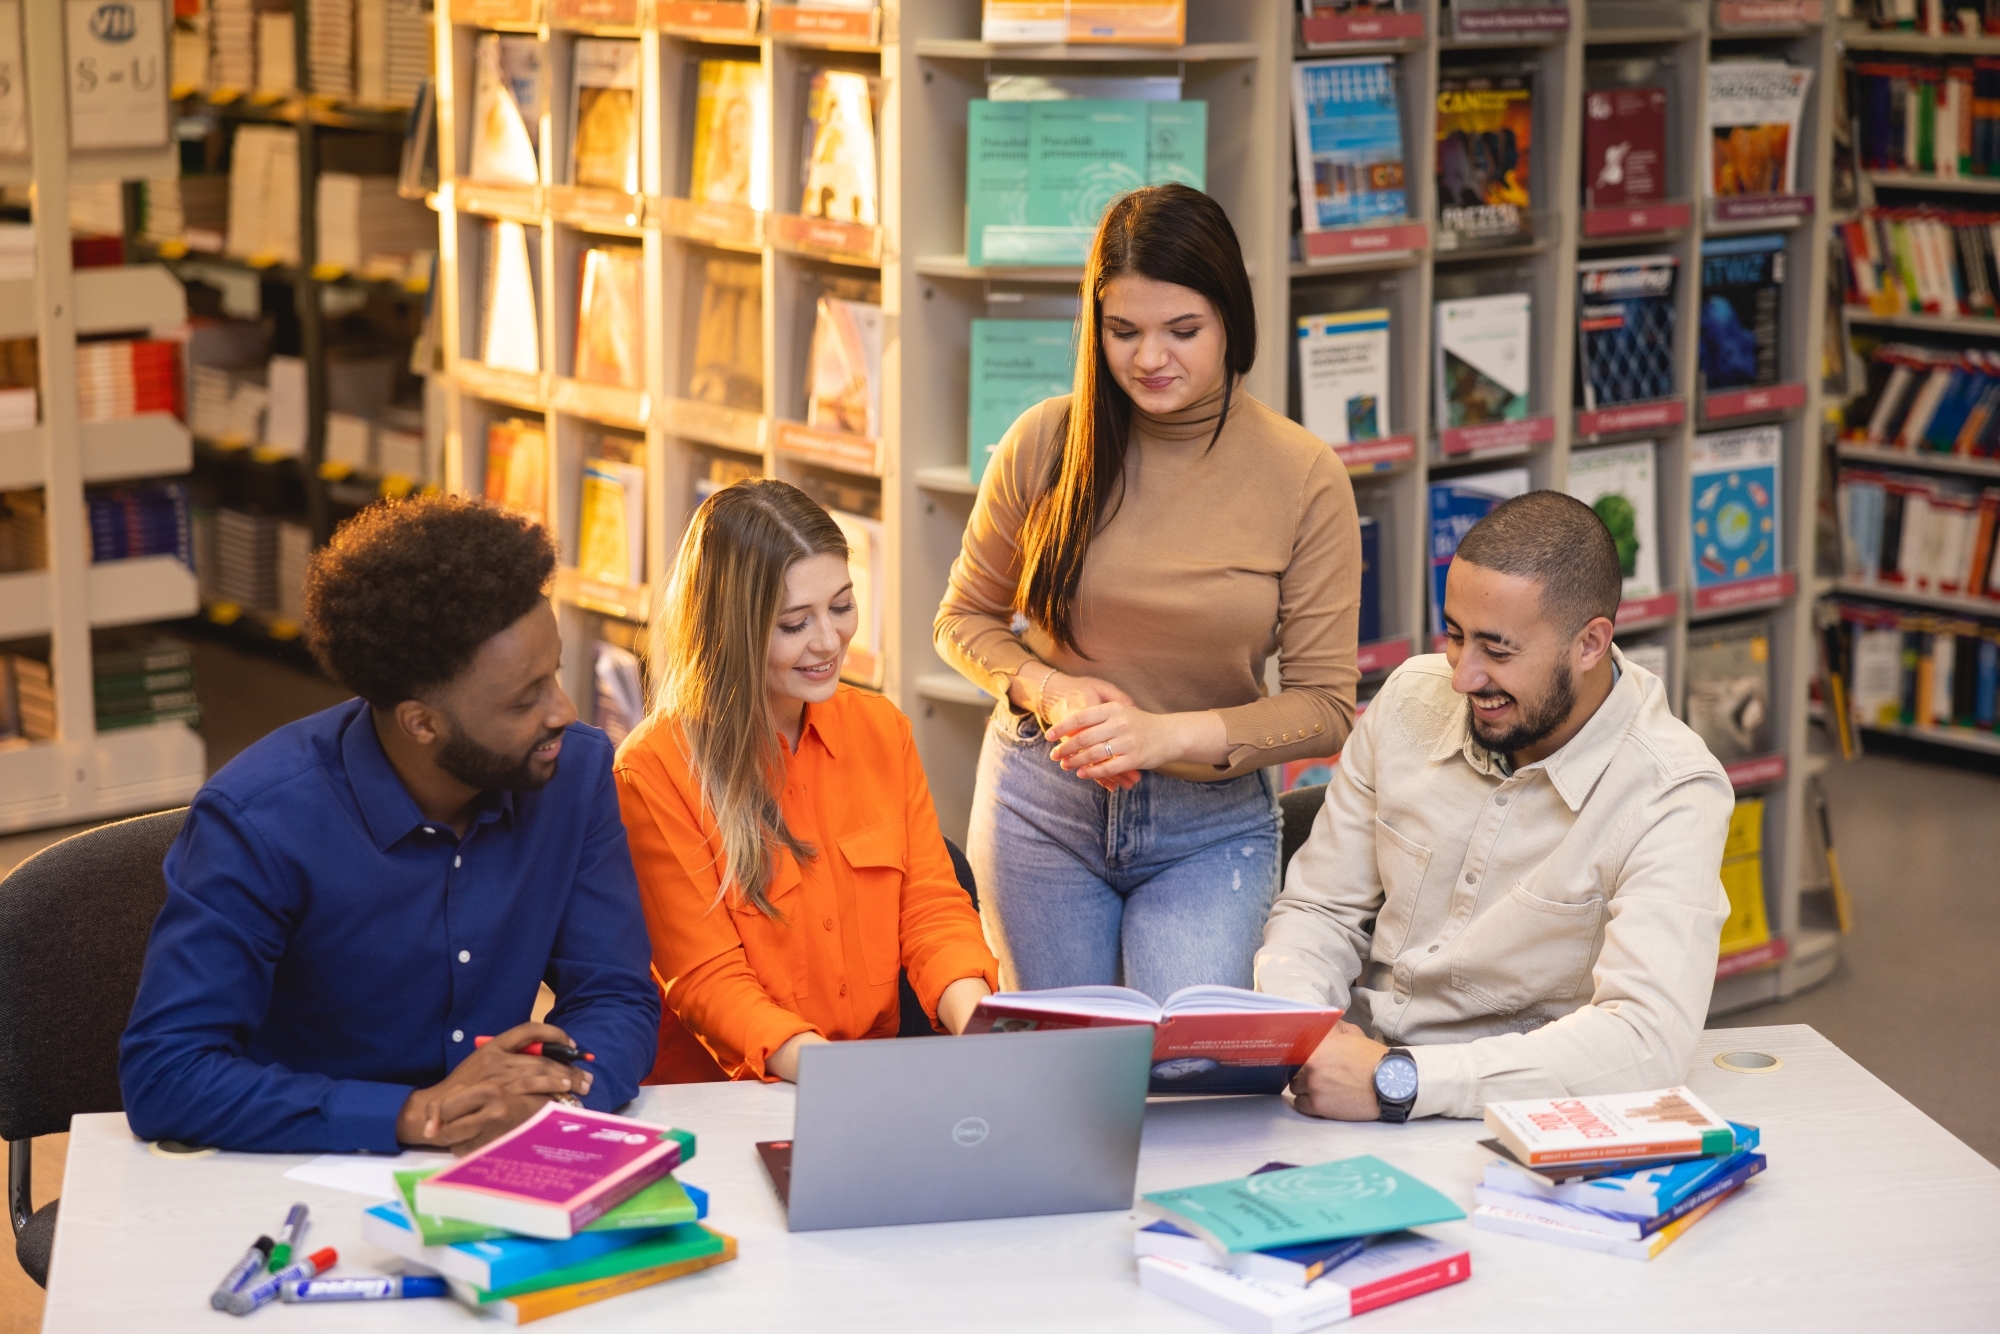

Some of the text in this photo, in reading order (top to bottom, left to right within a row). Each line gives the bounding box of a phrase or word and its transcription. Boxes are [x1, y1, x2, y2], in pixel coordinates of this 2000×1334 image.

[77, 56, 98, 93] S
[131, 55, 157, 93] U
[1528, 1112, 1573, 1131] POOR
[1550, 1100, 1618, 1138] ECONOMICS
[1605, 1148, 1626, 1156] ESTHER
[1627, 1146, 1647, 1154] DUFLO
